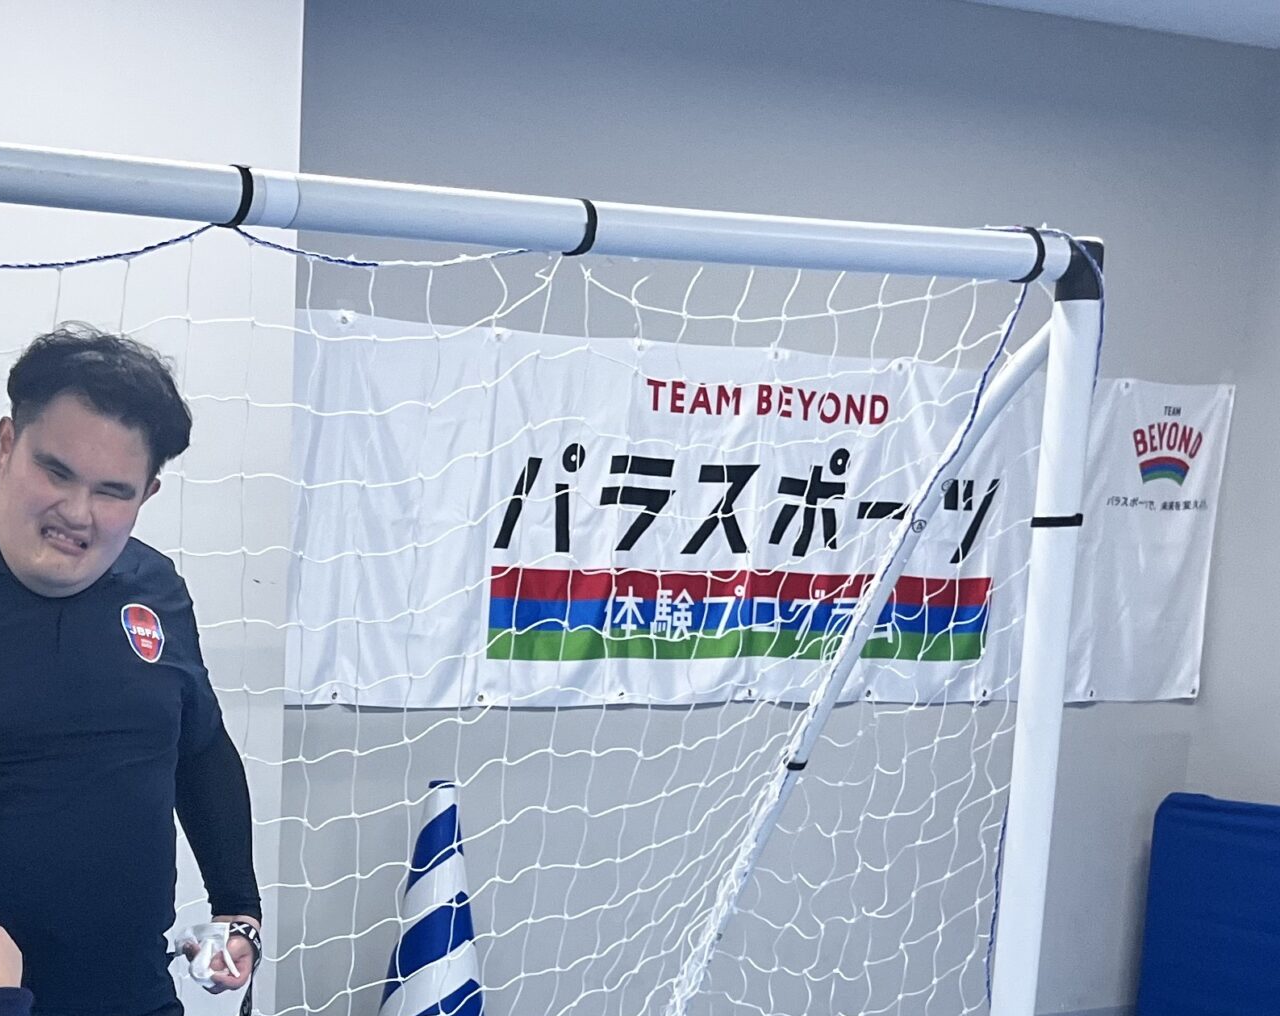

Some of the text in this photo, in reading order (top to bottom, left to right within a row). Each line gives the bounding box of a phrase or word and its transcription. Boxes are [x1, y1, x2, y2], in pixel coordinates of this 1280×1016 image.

[647, 378, 889, 425] TEAM BEYOND
[1163, 405, 1182, 416] TEAM
[1132, 421, 1203, 460] BEYOND
